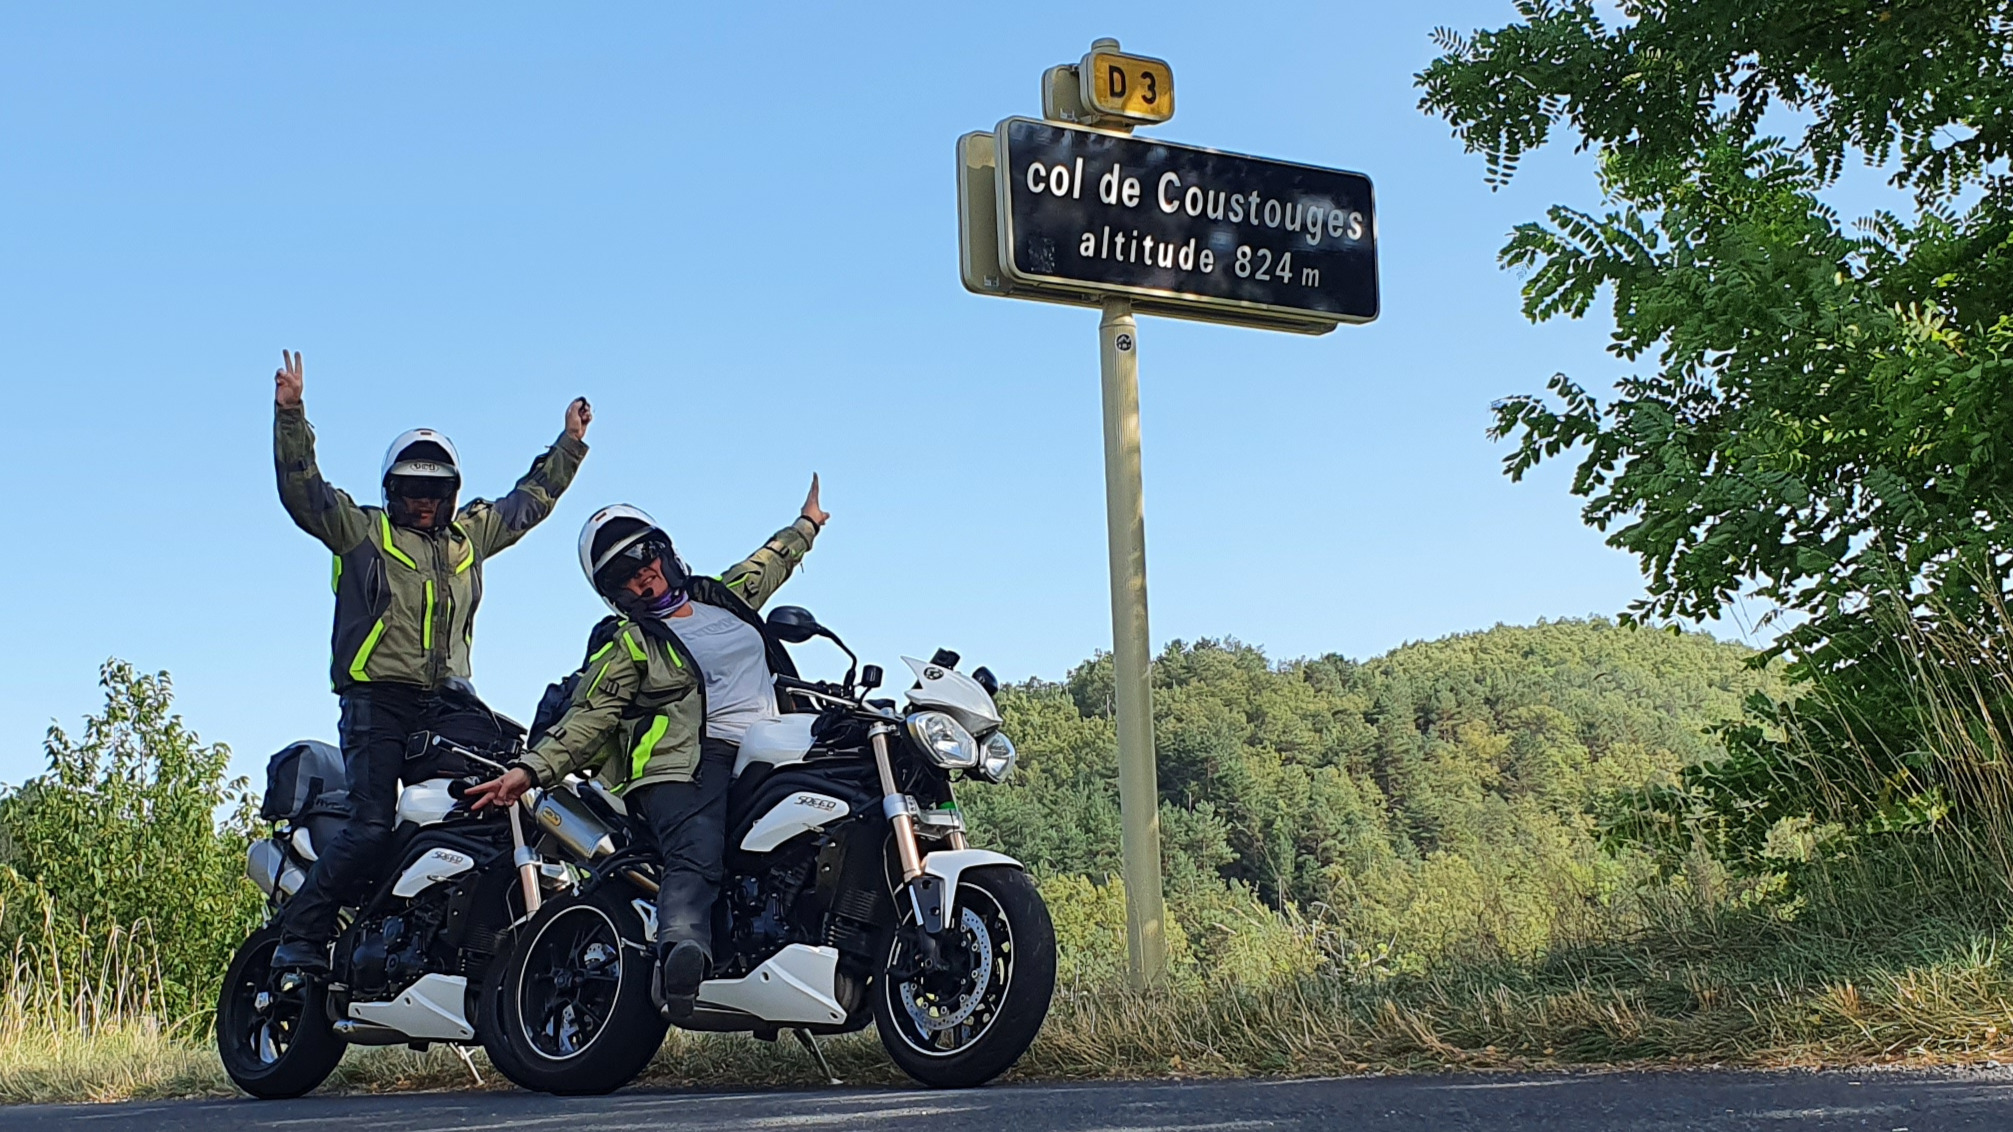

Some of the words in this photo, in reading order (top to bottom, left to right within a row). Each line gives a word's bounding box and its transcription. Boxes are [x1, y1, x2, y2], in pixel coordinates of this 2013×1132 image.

[1108, 65, 1127, 98] D
[1141, 71, 1157, 105] 3
[1026, 157, 1083, 199] col
[1099, 163, 1141, 208] de
[1157, 171, 1364, 246] Coustouges
[1079, 225, 1214, 273] altitude
[1234, 245, 1293, 284] 824
[1301, 267, 1320, 288] m
